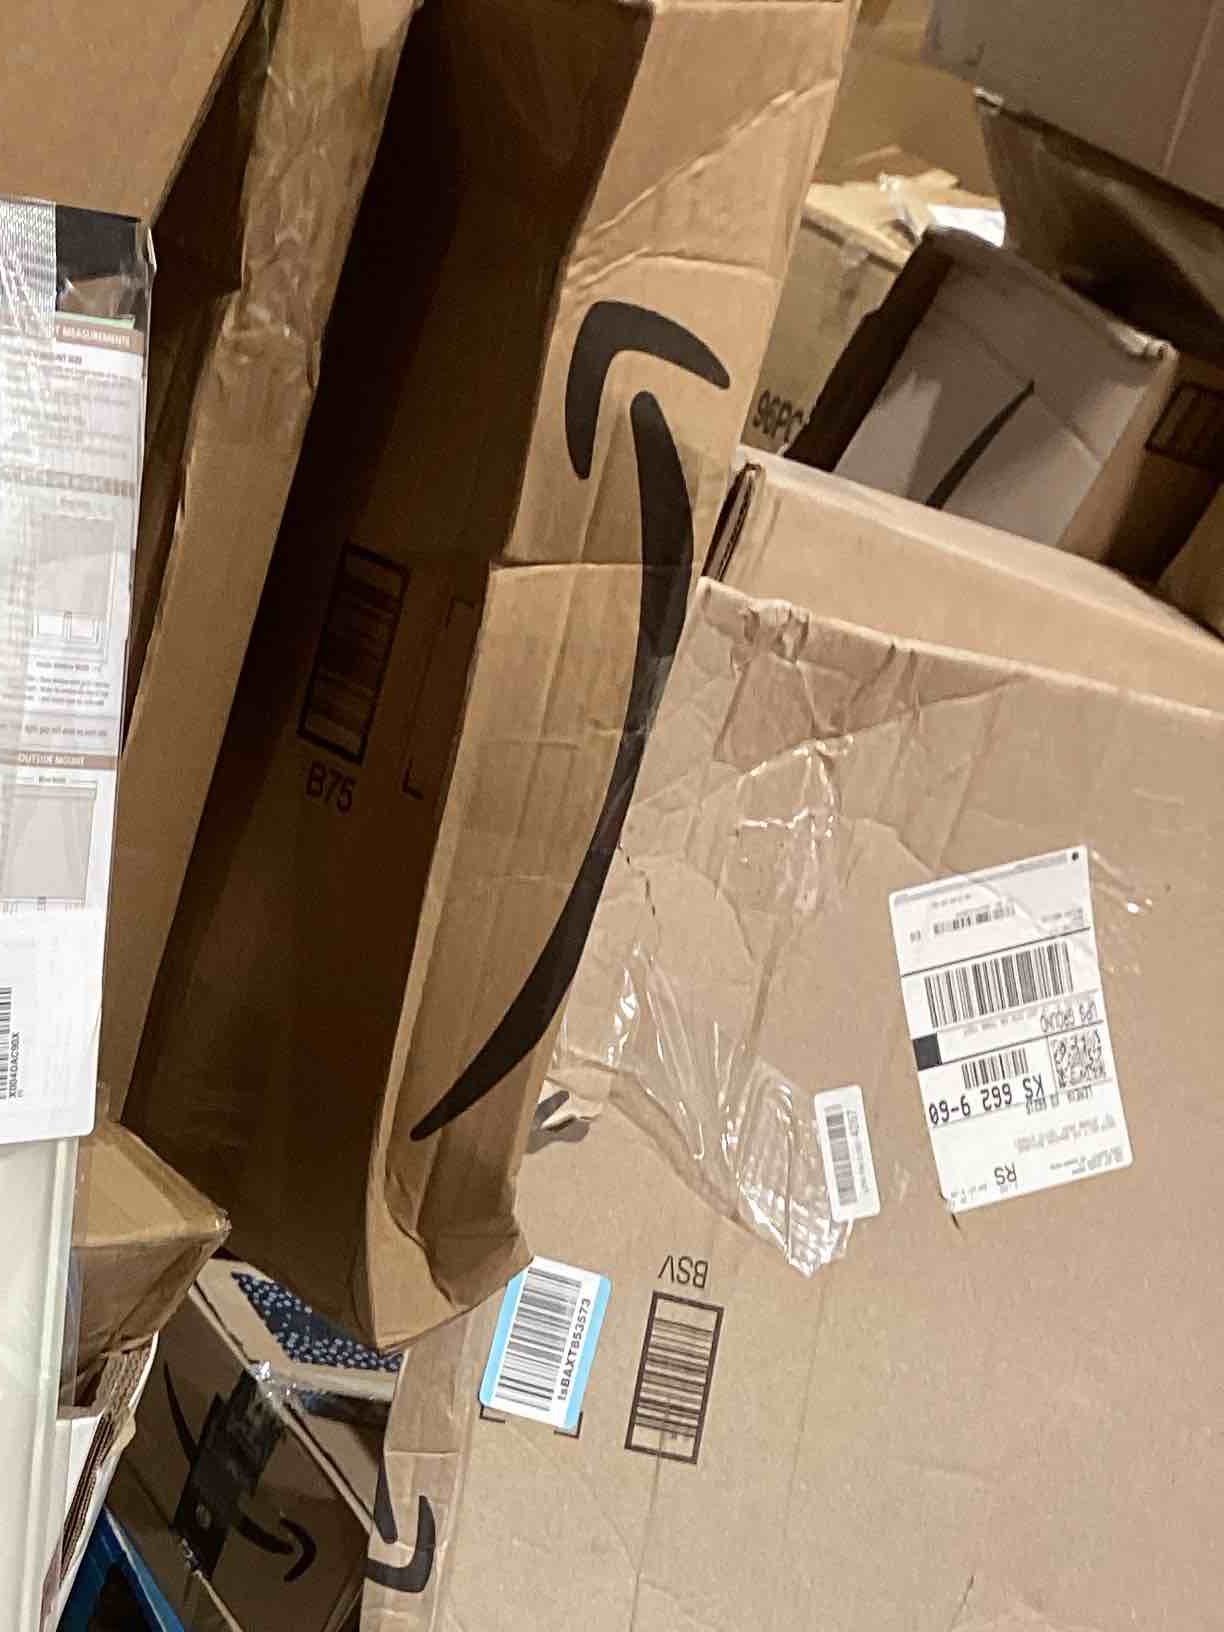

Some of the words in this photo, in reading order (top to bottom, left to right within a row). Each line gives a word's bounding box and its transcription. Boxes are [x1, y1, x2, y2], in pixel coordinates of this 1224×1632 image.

[305, 760, 357, 813] B75
[980, 1083, 1013, 1112] 662
[1022, 1072, 1046, 1103] KS
[928, 1095, 972, 1126] 9-60
[993, 1161, 1017, 1187] RS
[657, 1254, 708, 1289] BSV
